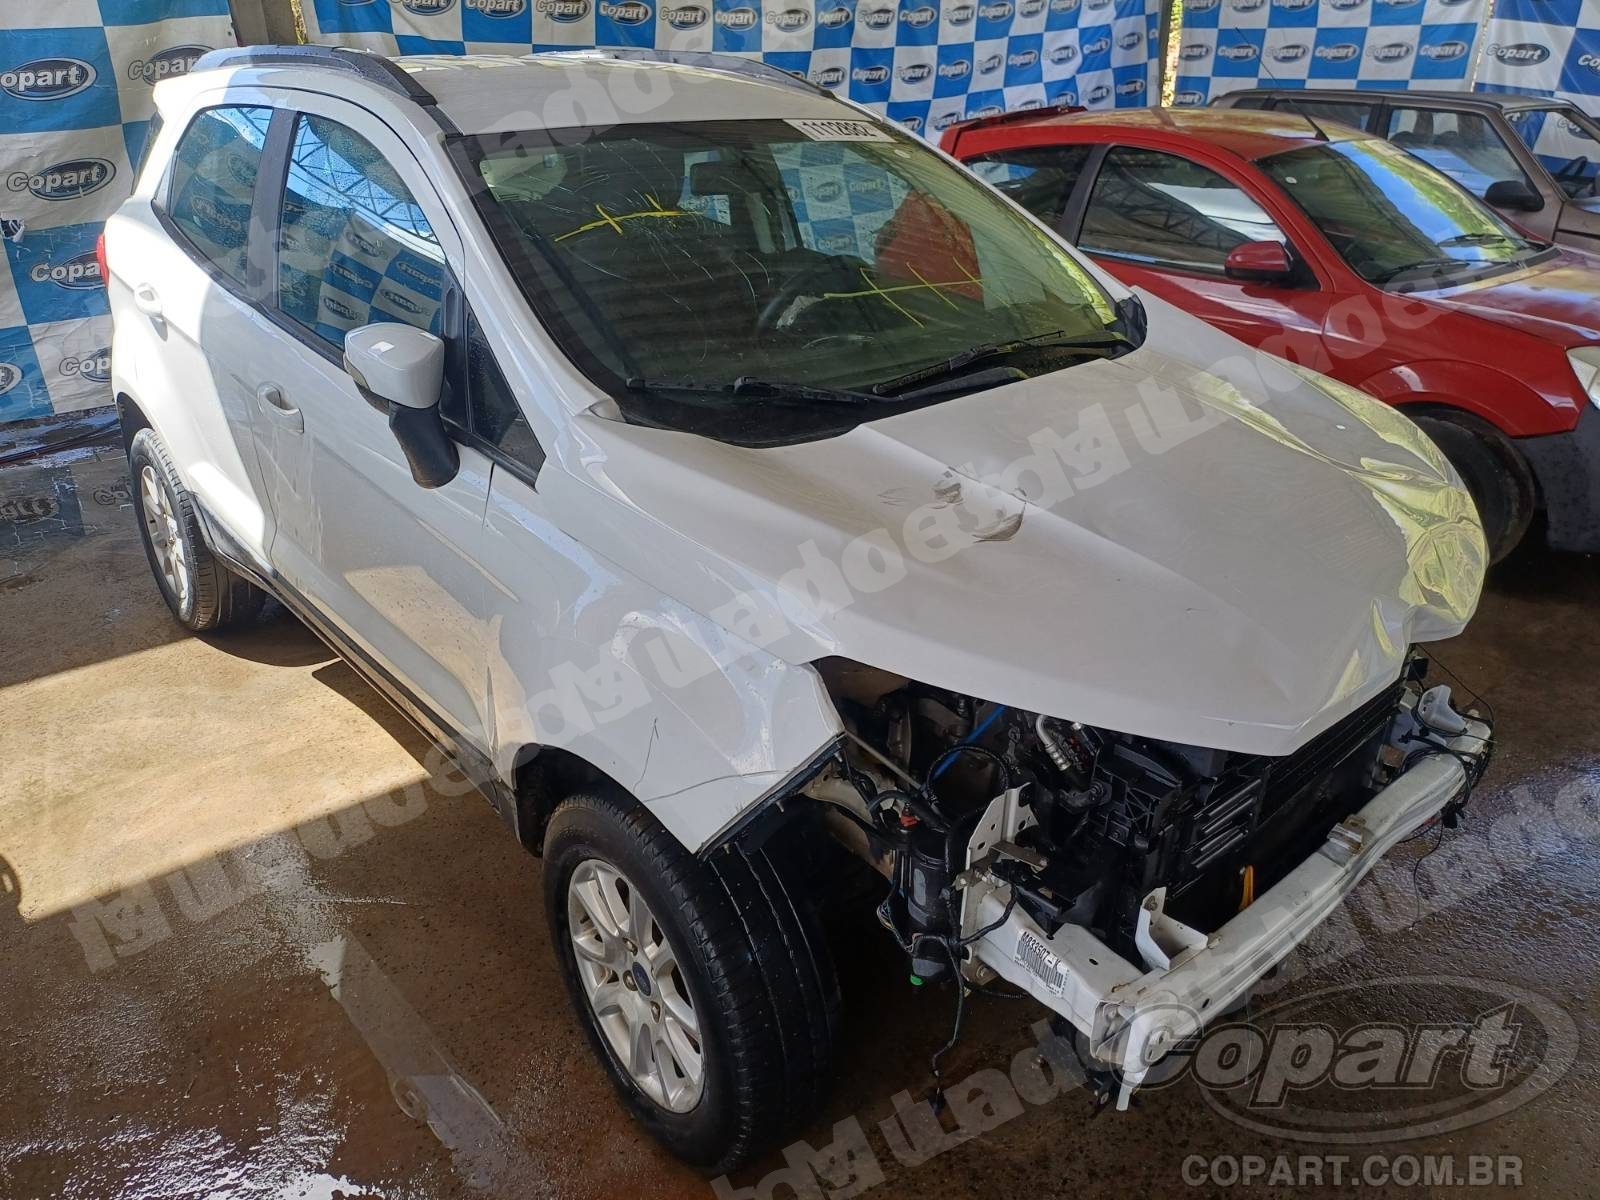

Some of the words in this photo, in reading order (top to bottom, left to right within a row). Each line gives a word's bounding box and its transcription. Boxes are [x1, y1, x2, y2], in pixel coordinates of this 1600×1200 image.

[536, 0, 586, 15] Copart
[599, 2, 646, 21] Copart
[659, 7, 704, 24] Copart
[715, 10, 755, 25] Copart
[766, 11, 805, 27] Copart
[817, 10, 848, 25] Copart
[858, 10, 893, 26] Copart
[901, 9, 935, 25] Copart
[1315, 45, 1355, 59] Copart
[1366, 45, 1408, 60] Copart
[1419, 43, 1463, 59] Copart
[1486, 43, 1542, 60] Copart
[128, 55, 199, 80] Copar
[852, 68, 887, 83] Copart
[895, 66, 931, 82] Copart
[0, 65, 81, 92] opart
[6, 163, 102, 193] Copart
[31, 260, 101, 283] Copa
